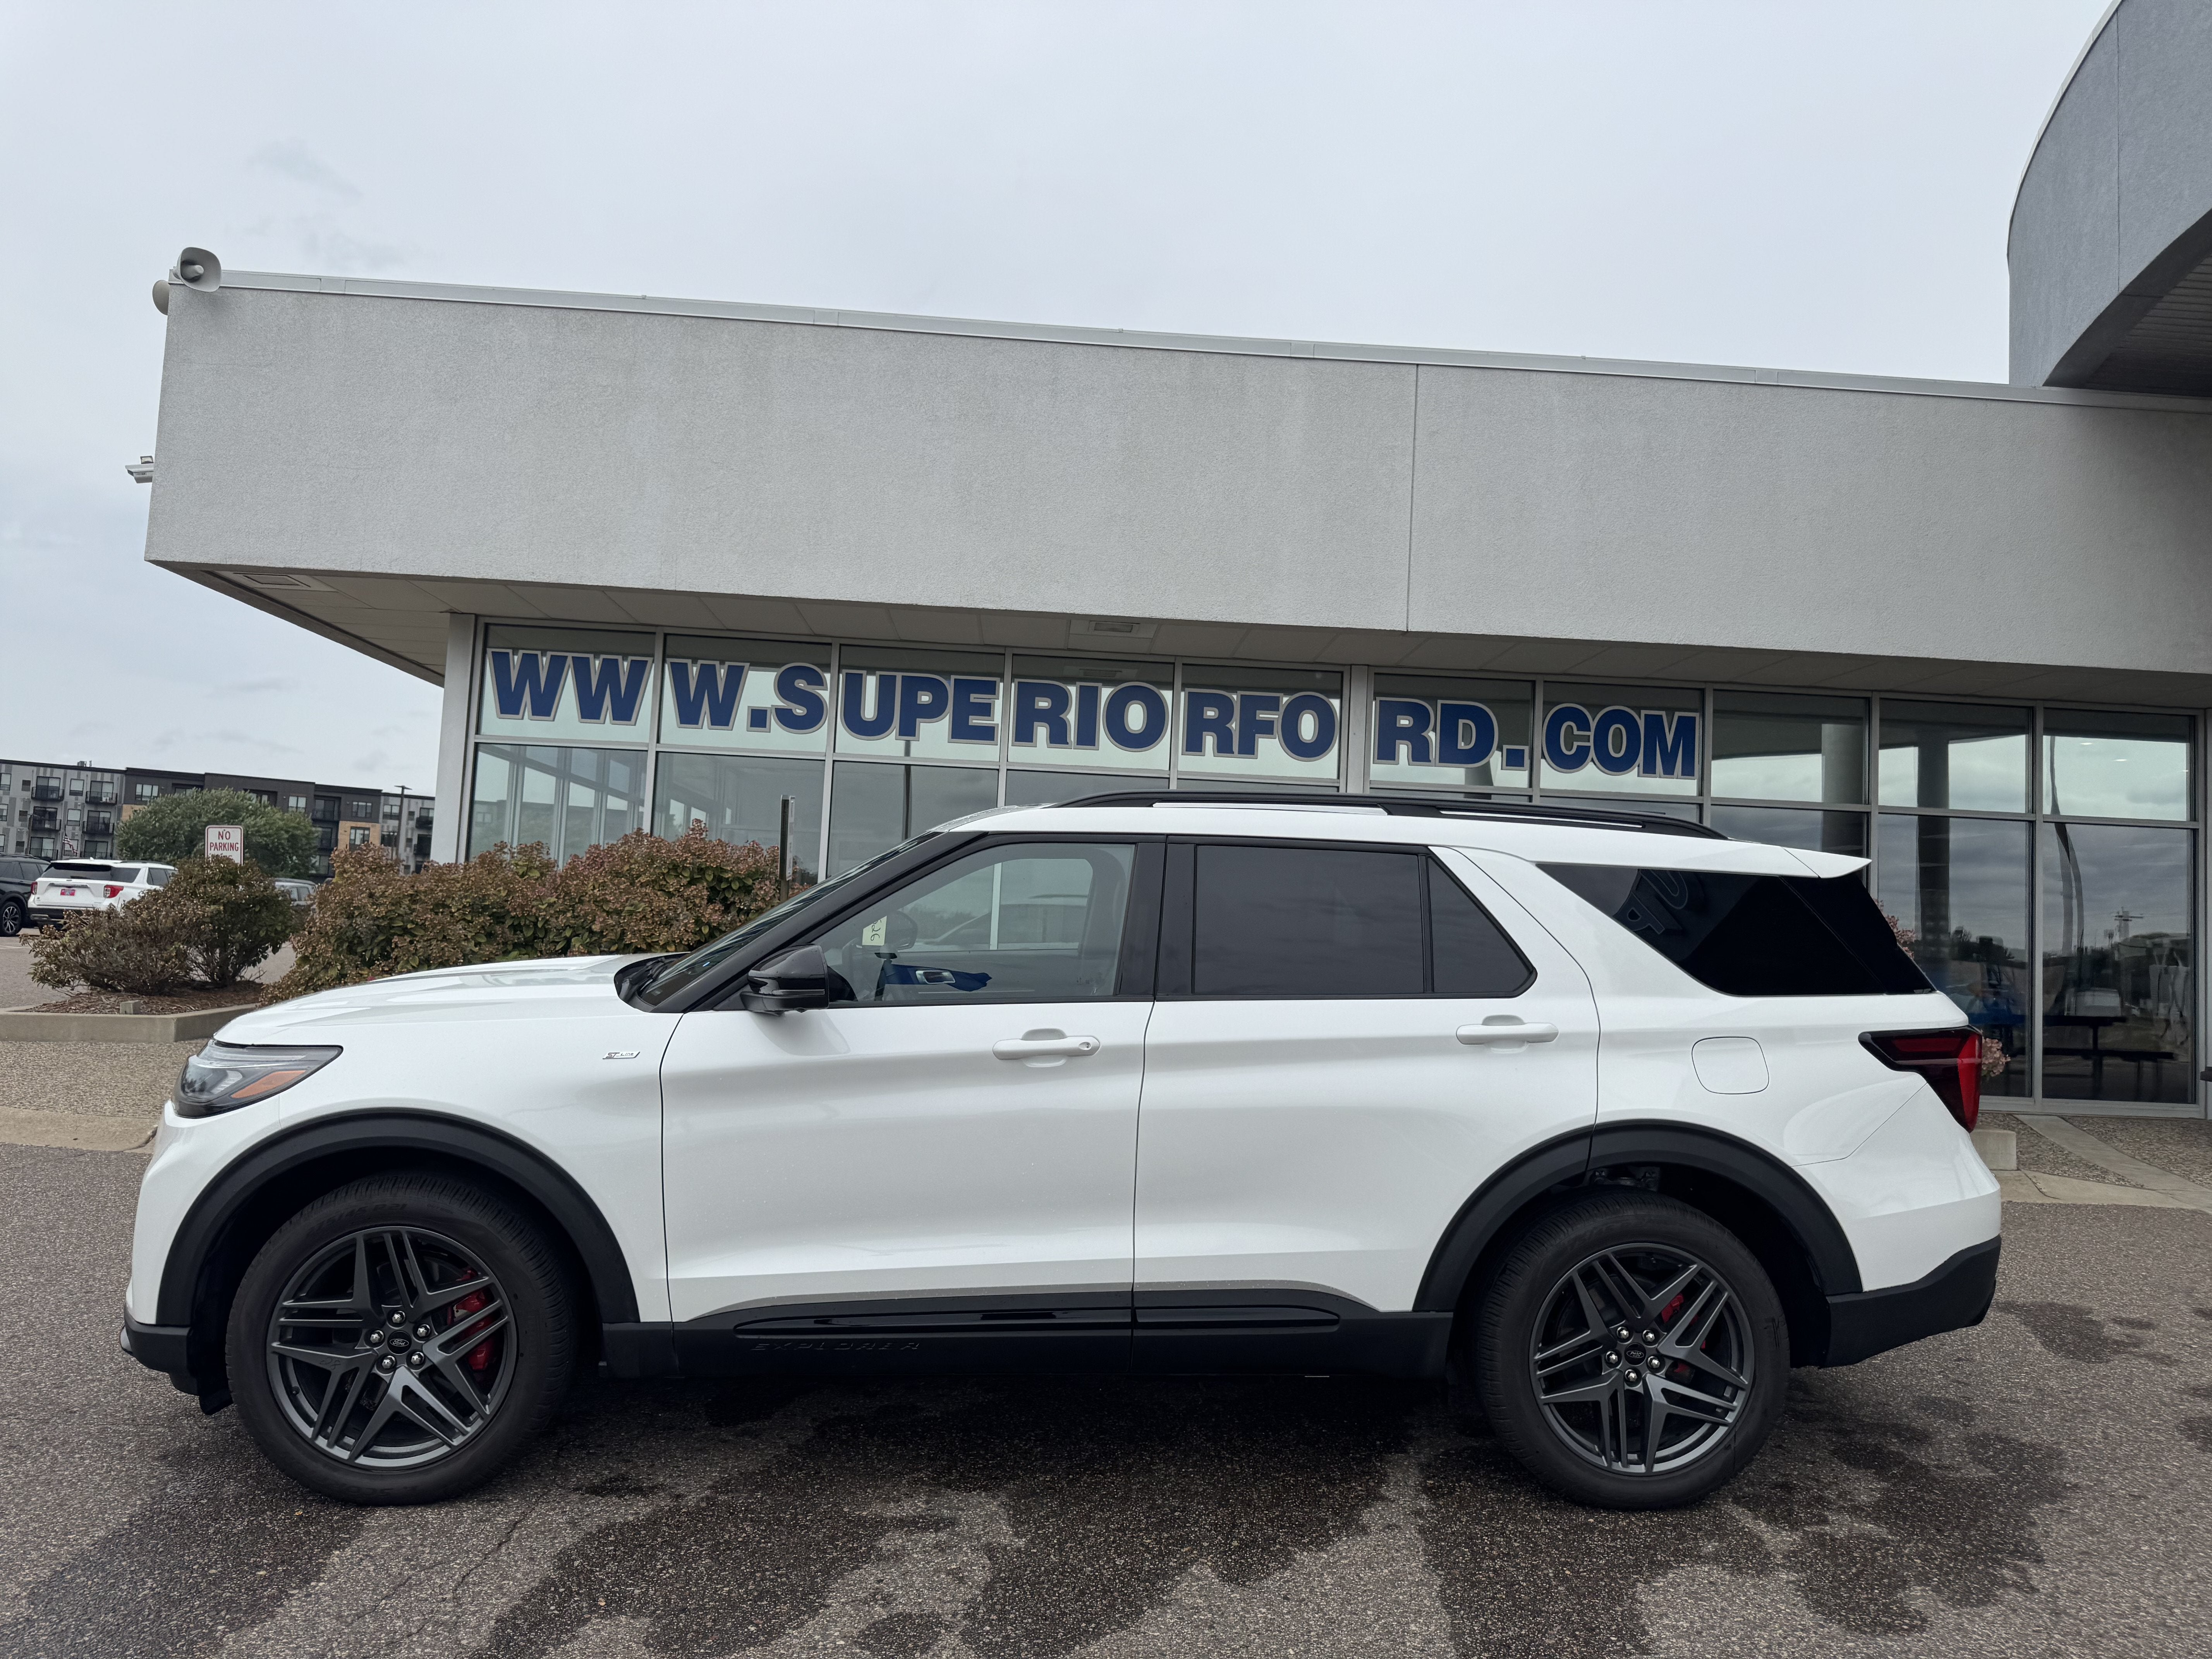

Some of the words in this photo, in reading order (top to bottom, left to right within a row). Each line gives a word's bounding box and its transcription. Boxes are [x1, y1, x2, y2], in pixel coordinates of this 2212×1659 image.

[218, 831, 230, 840] NO
[210, 842, 239, 851] PARKING
[750, 1342, 920, 1350] EXPLORER
